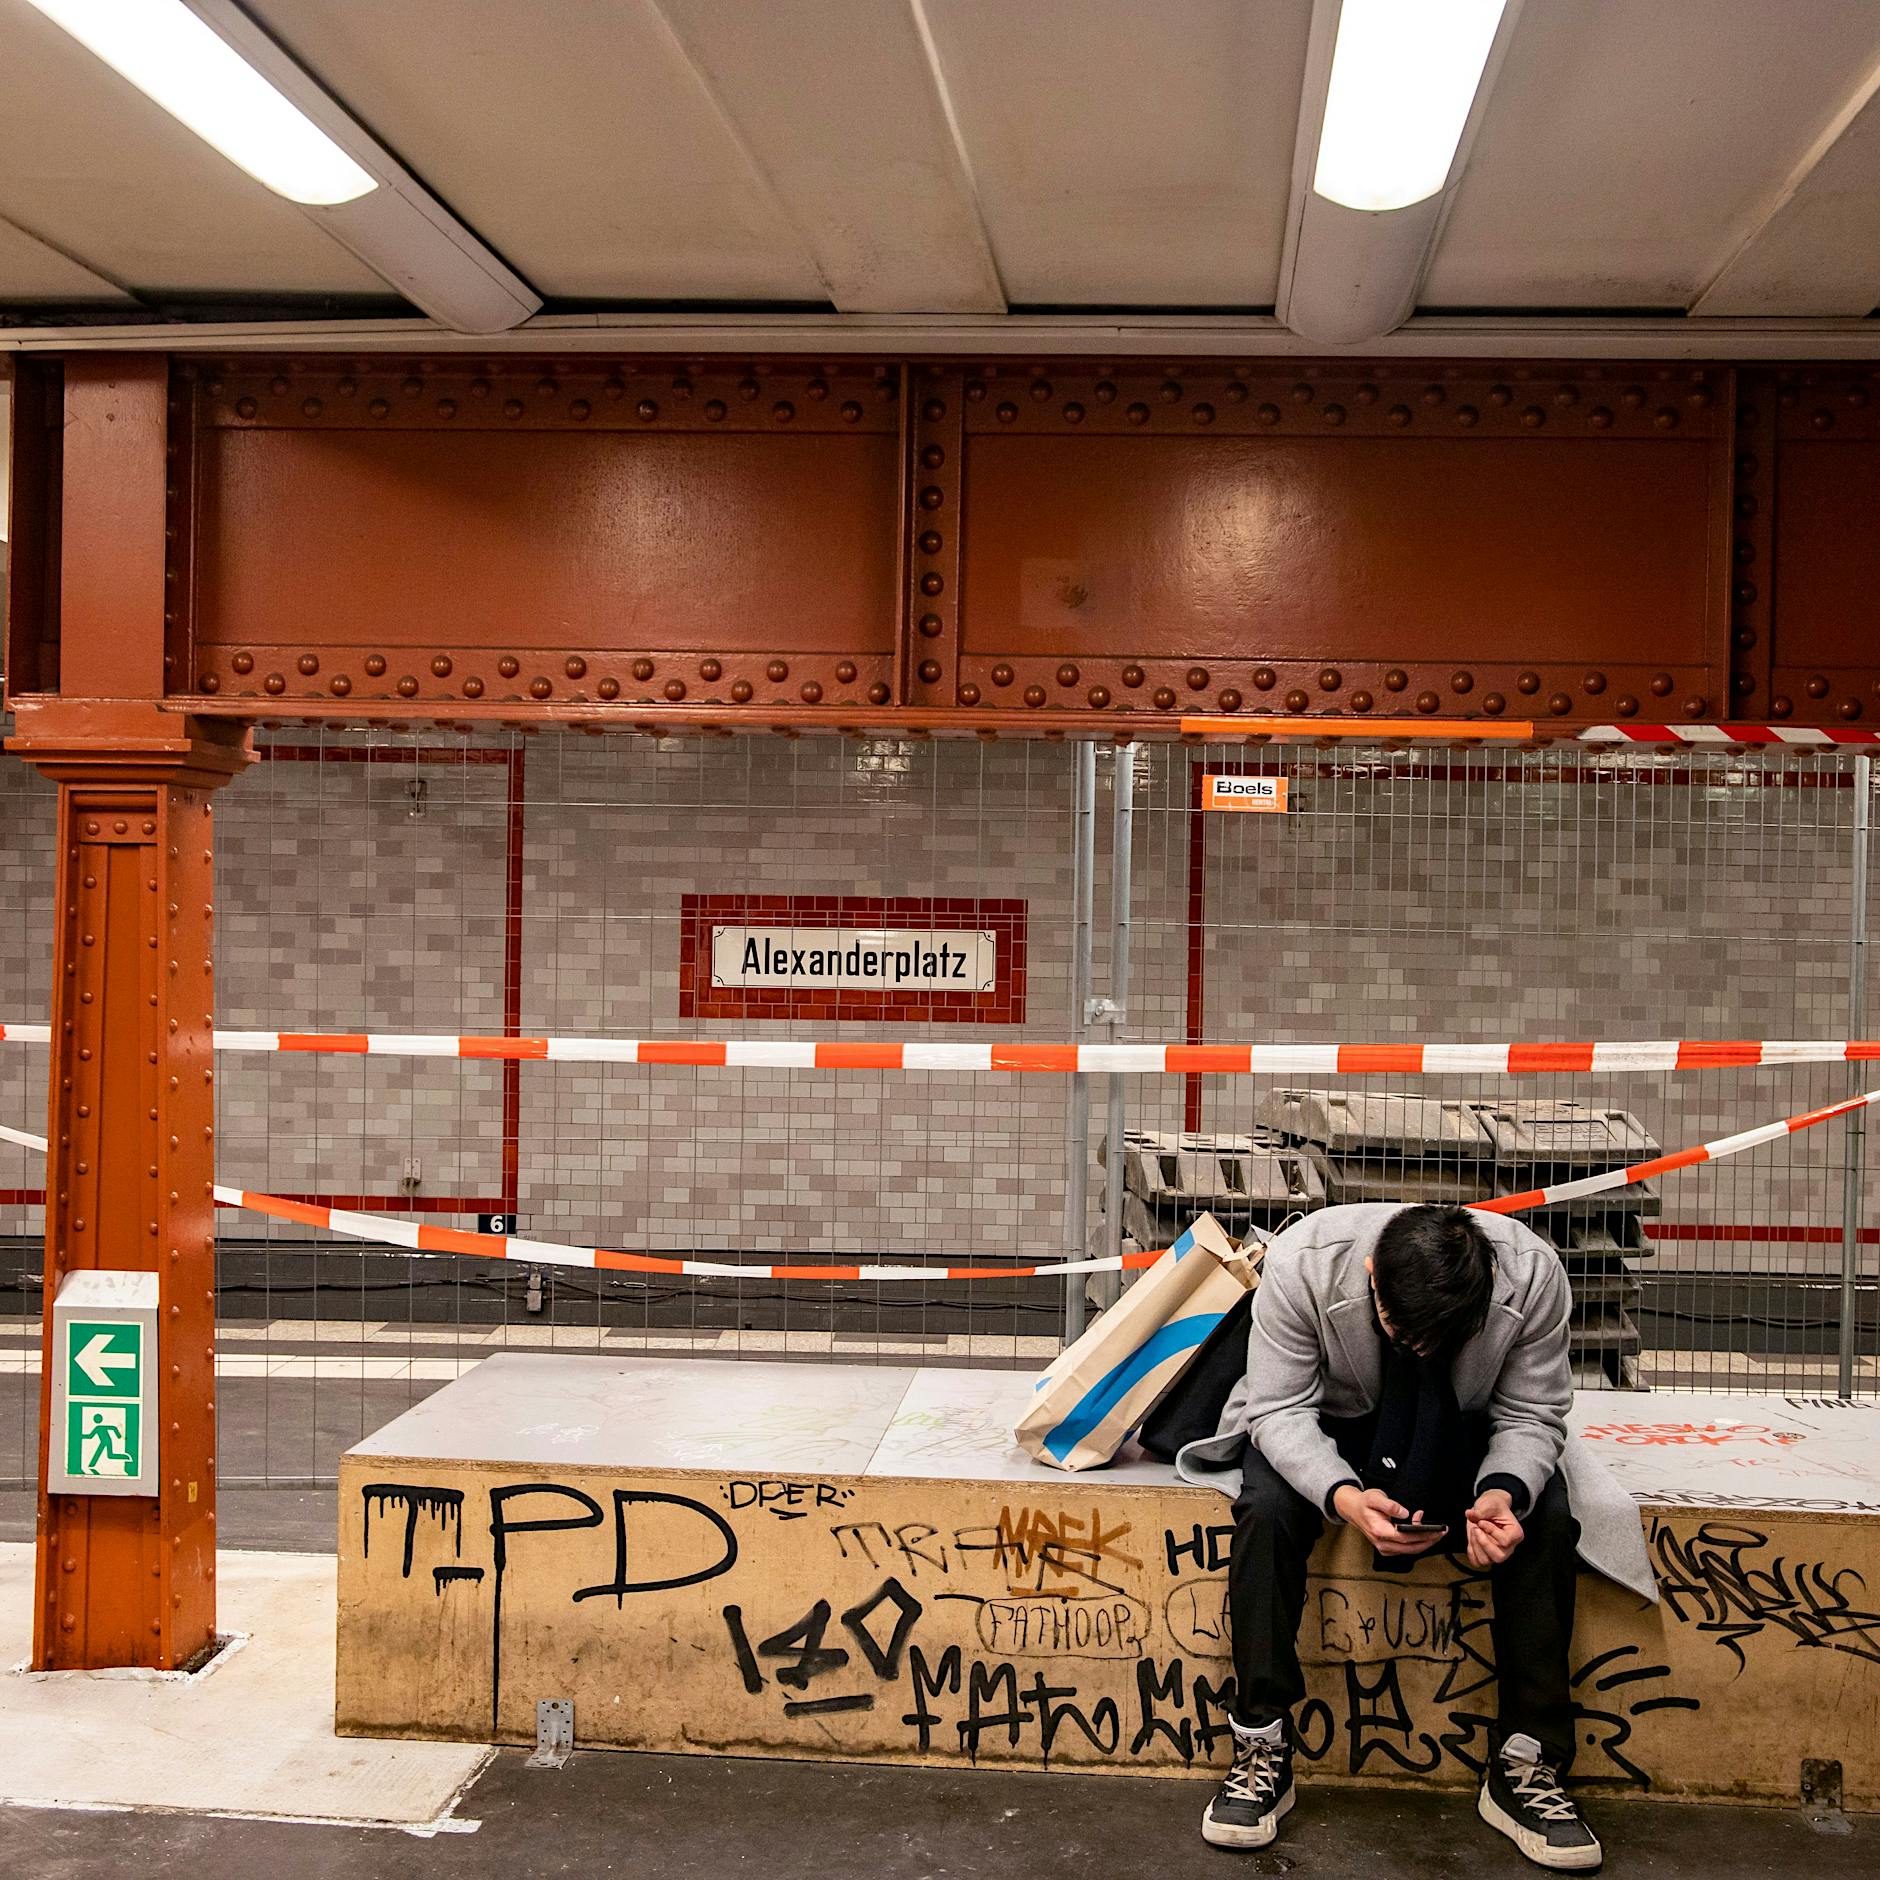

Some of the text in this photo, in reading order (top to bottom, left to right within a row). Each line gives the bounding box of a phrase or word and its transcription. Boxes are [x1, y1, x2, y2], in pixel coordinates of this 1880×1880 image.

[1216, 781, 1273, 795] Boels
[741, 937, 967, 983] Alexanderplatz
[490, 1215, 504, 1233] 6
